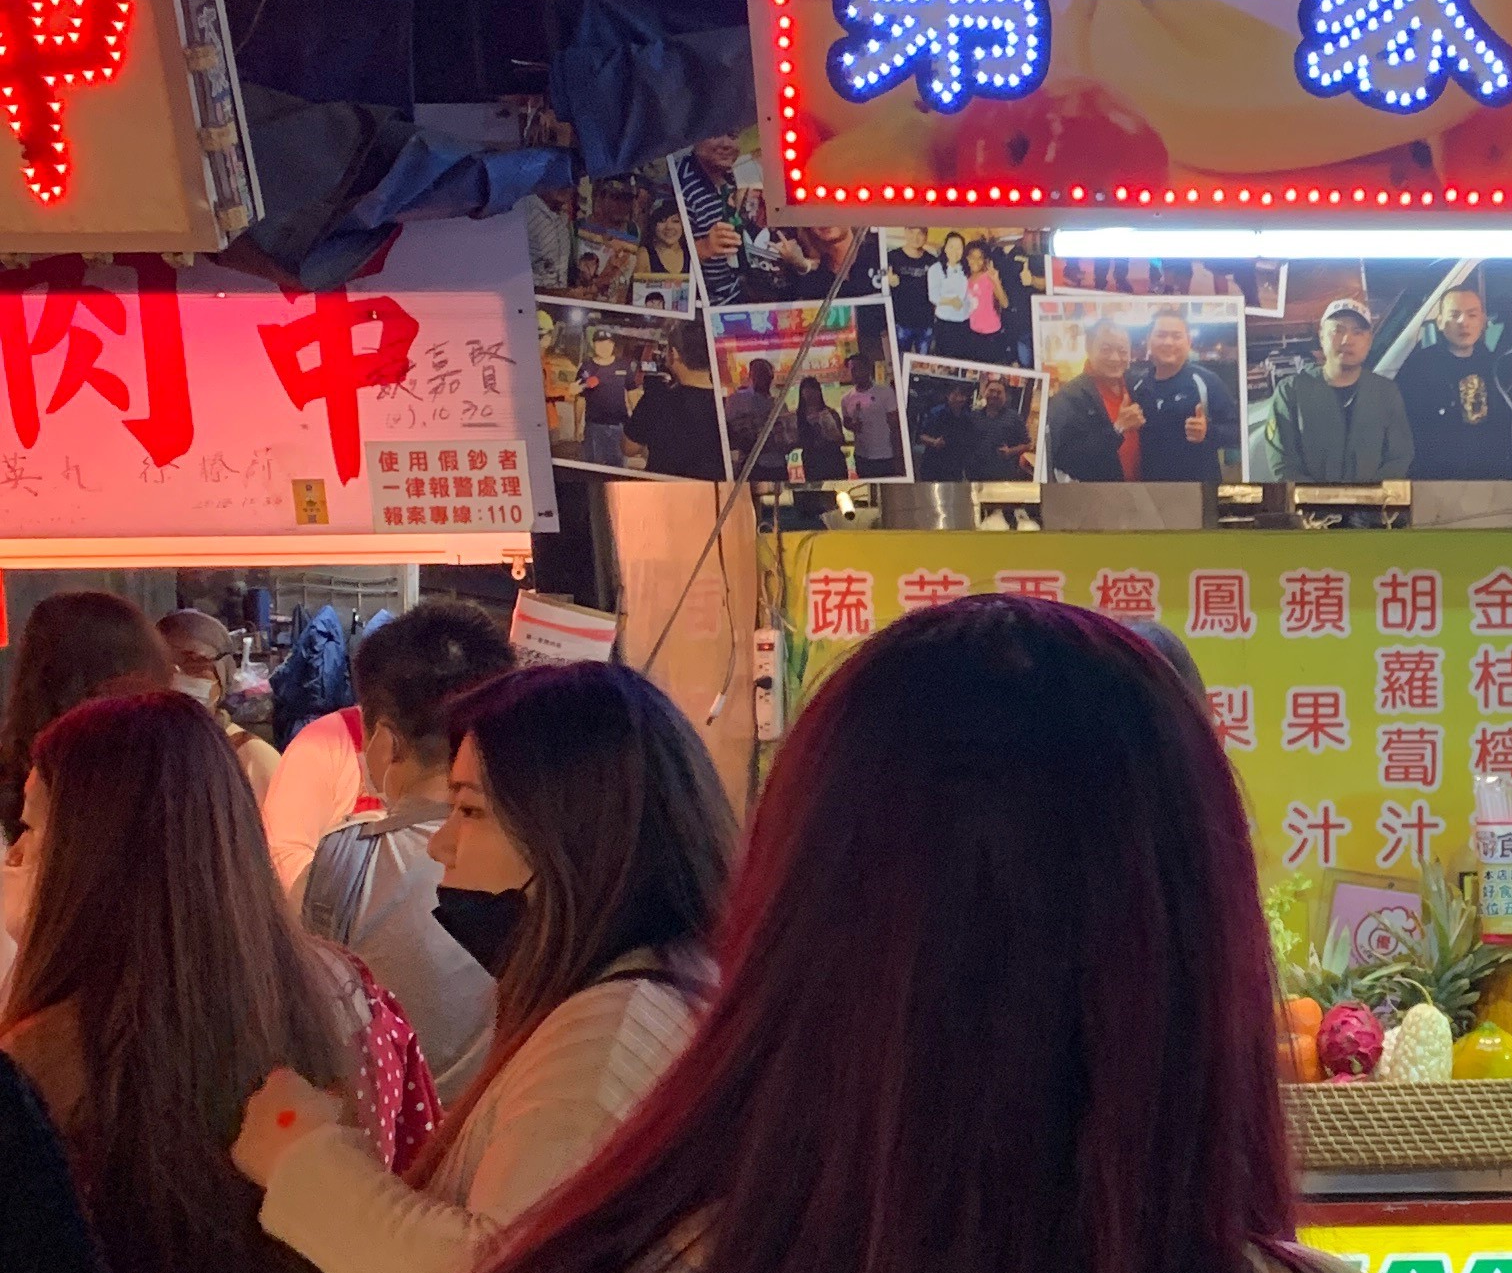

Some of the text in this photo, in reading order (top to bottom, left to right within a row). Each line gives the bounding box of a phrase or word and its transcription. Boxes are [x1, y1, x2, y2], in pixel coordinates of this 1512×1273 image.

[379, 449, 518, 472] 使用假鈔者
[382, 477, 522, 499] 一律報警處理
